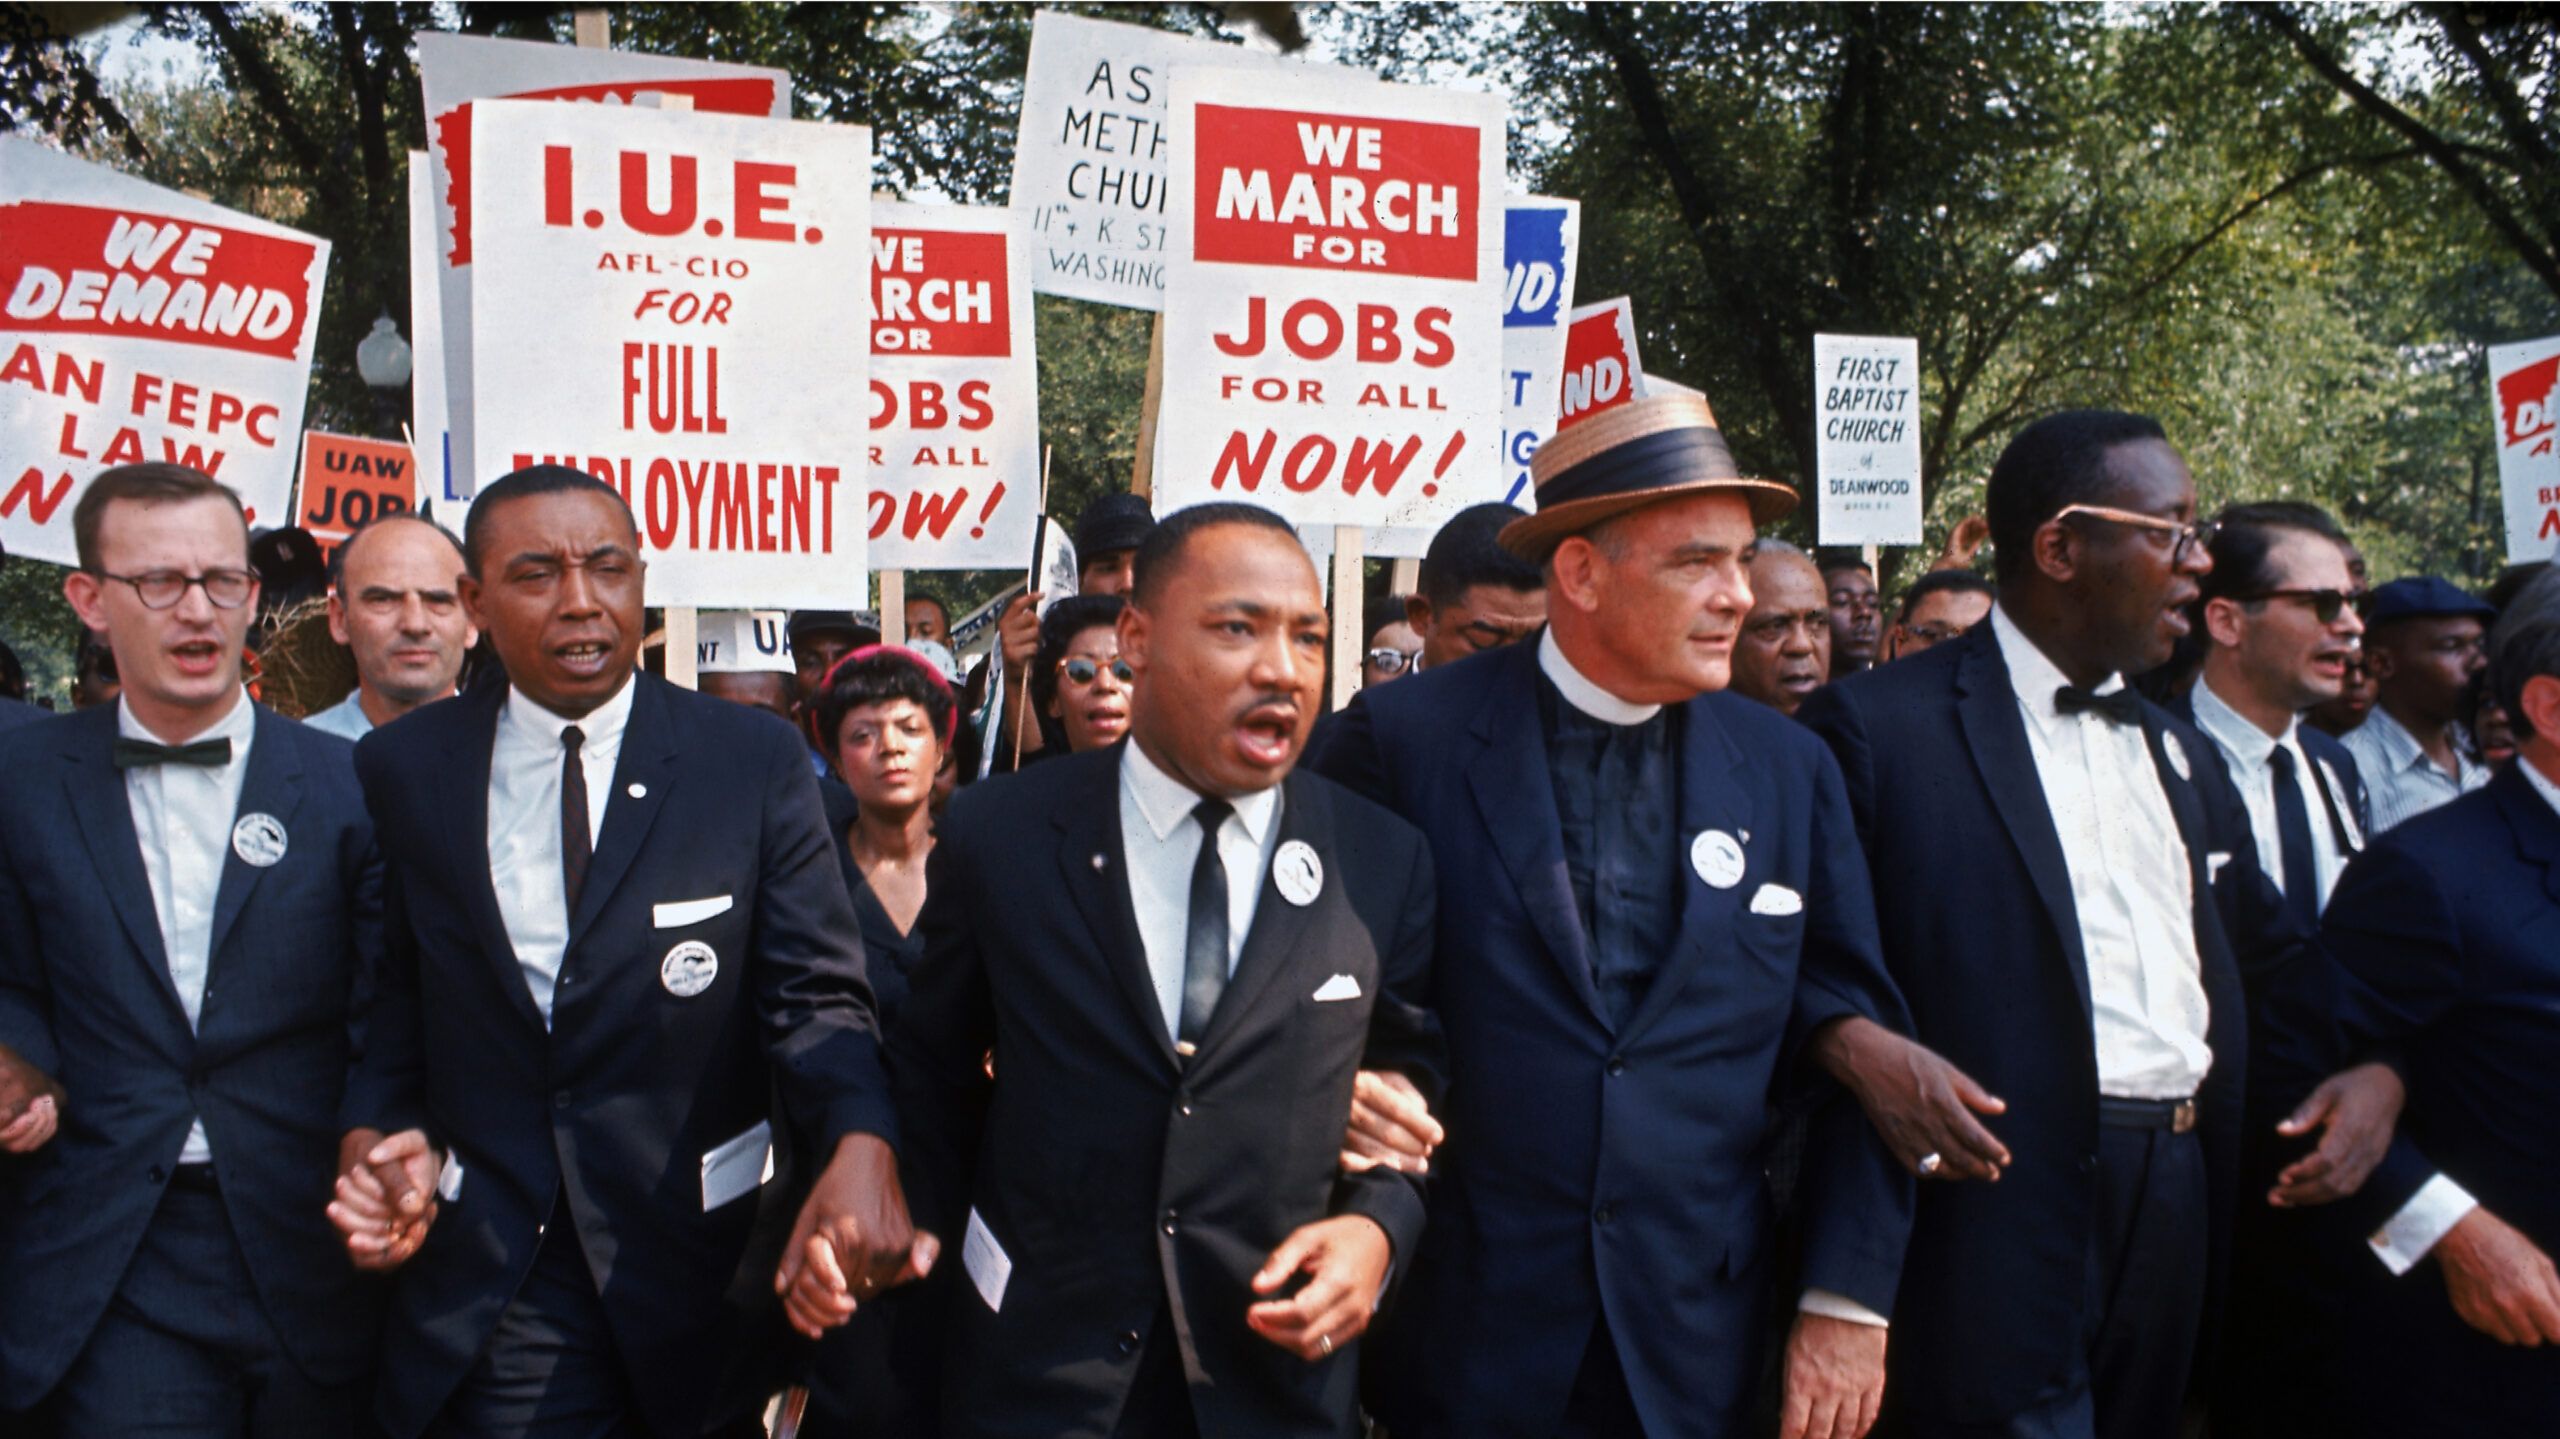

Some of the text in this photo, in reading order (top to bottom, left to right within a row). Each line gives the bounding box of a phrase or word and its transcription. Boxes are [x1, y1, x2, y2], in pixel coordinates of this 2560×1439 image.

[1085, 58, 1167, 109] AS
[1063, 106, 1167, 159] METH
[1297, 121, 1382, 171] WE
[544, 144, 824, 245] I.U.E.
[1215, 166, 1459, 237] MARCH
[103, 214, 222, 276] WE
[1097, 217, 1116, 244] K
[1293, 233, 1387, 266] FOR
[596, 252, 750, 279] AFL-CIO
[5, 265, 294, 341] DEMAND
[633, 288, 733, 326] FOR
[869, 277, 992, 324] RCH
[874, 327, 932, 351] OR
[1213, 295, 1456, 369] JOBS
[622, 341, 728, 434] FULL
[1220, 375, 1447, 411] FOR ALL
[1836, 356, 1900, 382] FIRST
[0, 342, 280, 448] AN FEPC
[868, 379, 995, 432] OBS
[1825, 386, 1910, 413] BAPTIST
[1826, 417, 1906, 443] CHURCH
[324, 449, 405, 480] UAW
[912, 446, 989, 467] ALL
[1210, 427, 1466, 498] NOW!
[512, 453, 840, 554] LOYMENT
[868, 480, 1006, 542] OW!
[1829, 477, 1910, 496] DEANWOOD
